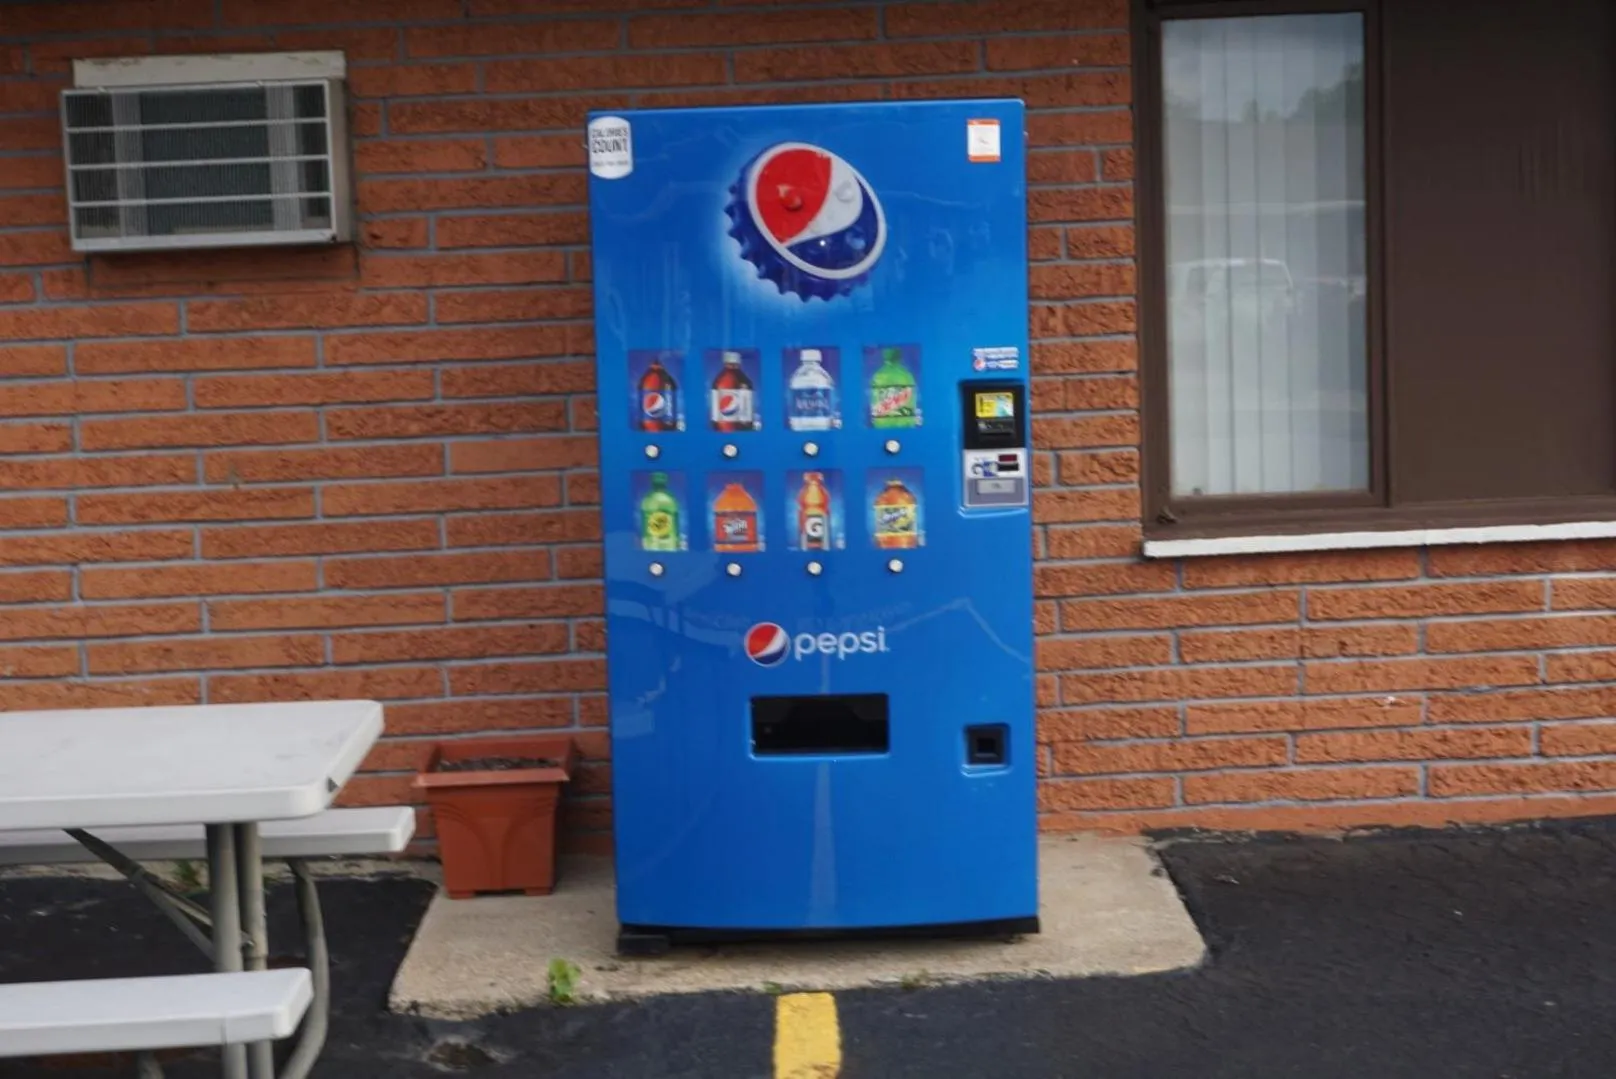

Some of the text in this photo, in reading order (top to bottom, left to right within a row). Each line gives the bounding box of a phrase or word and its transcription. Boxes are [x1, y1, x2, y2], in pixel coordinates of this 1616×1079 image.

[591, 138, 628, 153] COUNT
[806, 517, 823, 537] G
[794, 625, 885, 661] pepsi
